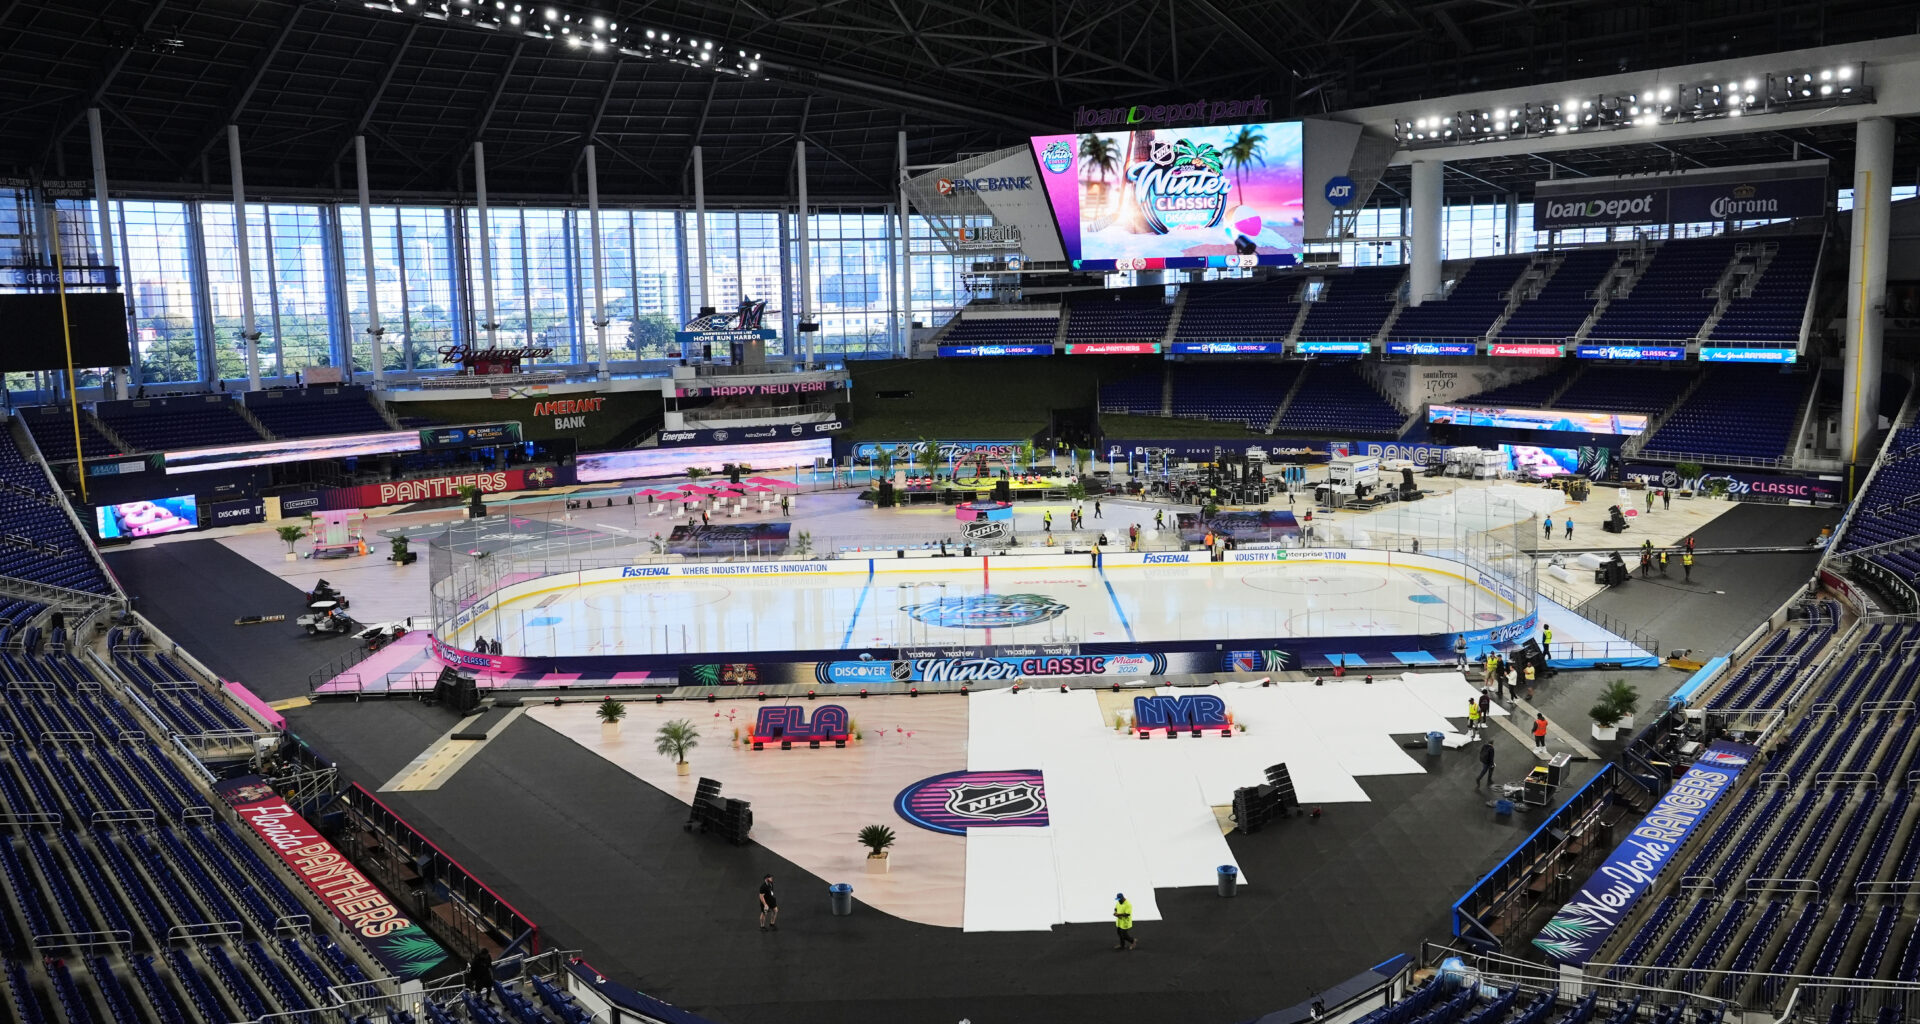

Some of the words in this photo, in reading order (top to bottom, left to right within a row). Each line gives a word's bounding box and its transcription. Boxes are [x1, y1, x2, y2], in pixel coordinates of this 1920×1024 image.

[1076, 102, 1207, 126] loanDepot
[1209, 95, 1269, 122] park
[1041, 150, 1073, 162] Winter
[1156, 145, 1170, 160] NHL
[43, 180, 66, 188] WORLD
[1126, 160, 1233, 203] Winter
[1328, 185, 1352, 198] ADT
[1156, 197, 1216, 211] CLASSIC
[1545, 195, 1653, 219] loanDepot
[1710, 197, 1778, 220] Corona
[1165, 213, 1209, 223] DISCOVER
[1008, 260, 1018, 268] 42
[438, 344, 553, 365] Budweiser
[977, 346, 1005, 357] Winter
[1209, 344, 1237, 354] Winter
[1411, 343, 1439, 355] Winter
[1495, 346, 1518, 354] Florida
[1517, 347, 1556, 355] PANTHERS
[1607, 346, 1642, 359] Winter
[1711, 351, 1726, 359] New
[1725, 351, 1745, 360] York
[1744, 352, 1783, 360] RANGERS
[711, 385, 756, 397] HAPPY
[760, 384, 790, 395] NEW
[792, 381, 827, 393] YEAR!
[1425, 379, 1455, 393] 1796
[533, 397, 603, 416] AMERANT
[554, 416, 586, 430] BANK
[814, 421, 842, 433] GEICO
[661, 432, 697, 442] Energizer
[911, 441, 972, 459] Wnter
[380, 472, 507, 503] PANTHERS
[1683, 474, 1750, 494] Wter
[1751, 481, 1808, 496] CLASSIC
[218, 508, 250, 519] DISCOVER
[971, 524, 999, 538] NHL
[1142, 552, 1191, 564] FASTENAL
[1277, 550, 1324, 559] enterprise
[622, 566, 671, 578] FASTENAL
[682, 567, 710, 575] WHERE
[711, 565, 750, 574] INDUSTRY
[752, 564, 779, 573] MEETS
[780, 563, 828, 573] INNOVATION
[1479, 573, 1497, 593] FASTENAL
[1498, 624, 1525, 642] Winter
[440, 646, 462, 664] Winter
[463, 655, 491, 666] CLASSIC
[1111, 655, 1146, 665] Miami
[834, 666, 887, 678] DISCOVER
[895, 664, 908, 677] NHL
[916, 658, 1018, 681] Winter
[1022, 657, 1106, 676] CLASSIC
[1116, 665, 1139, 674] 2026
[1134, 695, 1228, 730] NYR
[755, 705, 848, 742] FLA
[968, 790, 1024, 812] NHL
[1633, 769, 1729, 845] RANGERS
[1601, 839, 1670, 883] York
[239, 804, 318, 850] Florida
[287, 841, 411, 938] PANTHERS
[1577, 880, 1636, 927] New
